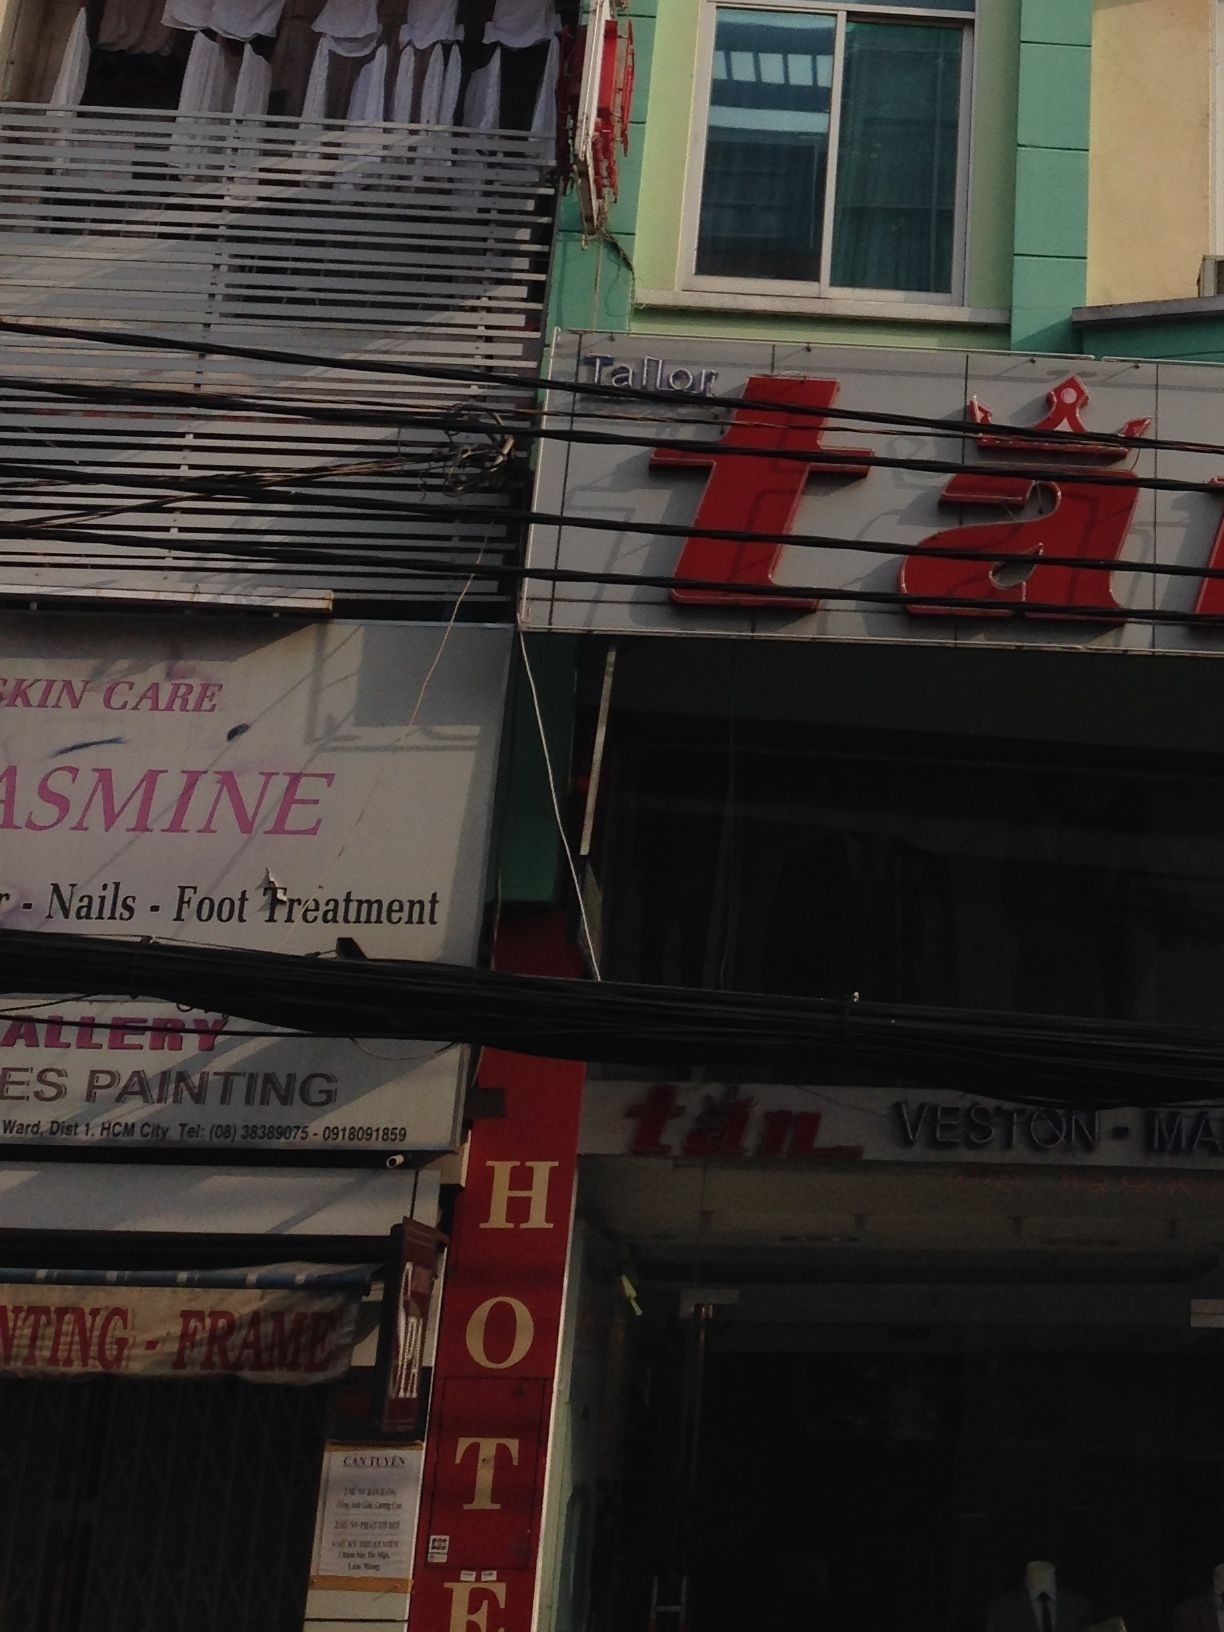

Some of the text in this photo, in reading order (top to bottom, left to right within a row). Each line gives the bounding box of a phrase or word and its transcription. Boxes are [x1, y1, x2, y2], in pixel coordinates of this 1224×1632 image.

[583, 354, 719, 396] Tailor
[103, 681, 223, 712] CARE
[45, 881, 137, 922] Nails
[173, 885, 249, 923] Foot
[263, 886, 439, 926] Treatment
[0, 1015, 229, 1052] ALLERY
[0, 1067, 338, 1107] ES PAINTING
[3, 1119, 43, 1136] Ward,
[50, 1120, 78, 1136] Dist
[101, 1122, 135, 1137] HCM
[140, 1122, 168, 1141] City
[179, 1123, 205, 1139] Tel:
[210, 1124, 237, 1141] (08)
[241, 1125, 309, 1141] 38389075
[895, 1100, 1099, 1152] VESTON
[171, 1309, 343, 1371] FRAME
